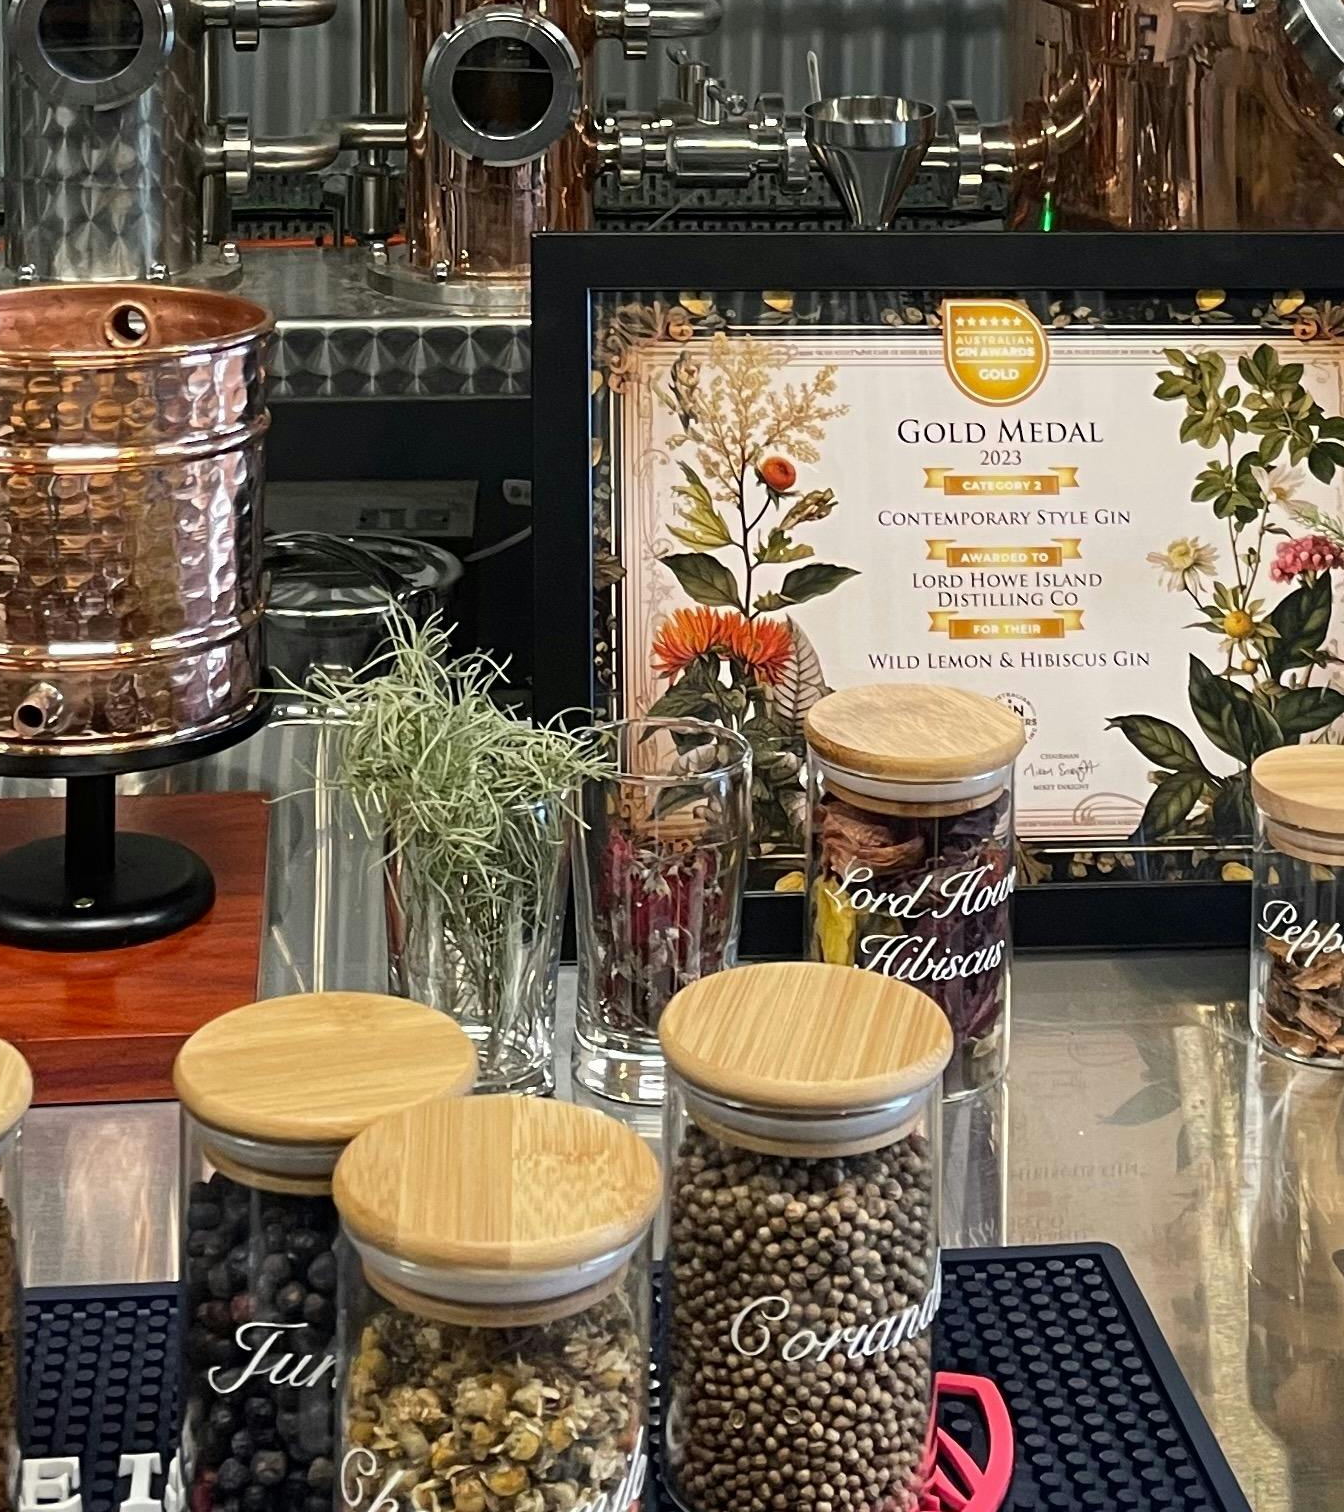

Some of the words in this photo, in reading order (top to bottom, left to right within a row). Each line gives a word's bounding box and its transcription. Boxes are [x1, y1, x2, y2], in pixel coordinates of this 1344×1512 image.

[955, 335, 1034, 345] AUSTRALIAN
[979, 368, 1020, 381] GOLD
[897, 418, 986, 444] GOLD
[998, 418, 1104, 444] MEDAL
[979, 449, 1022, 466] 2023
[961, 480, 1031, 491] CATEGORY
[1034, 480, 1042, 490] 2
[878, 510, 1030, 526] CONTEMPORARY
[1037, 509, 1089, 525] STYLE
[1094, 508, 1131, 525] GIN
[960, 553, 1028, 563] AWARDED
[1032, 552, 1049, 563] TO
[912, 572, 963, 589] LORD
[970, 572, 1029, 588] HOWE
[1036, 571, 1103, 588] ISLAND
[938, 591, 1044, 608] DISTILLING
[973, 624, 999, 634] FOR
[1003, 624, 1041, 634] THEIR
[868, 653, 920, 670] WILD
[927, 652, 992, 669] LEMON
[999, 652, 1013, 668] &
[1020, 651, 1107, 668] HIBISCUS
[1113, 650, 1150, 667] GIN
[825, 858, 934, 919] Lord
[854, 934, 1006, 982] Hibiscus
